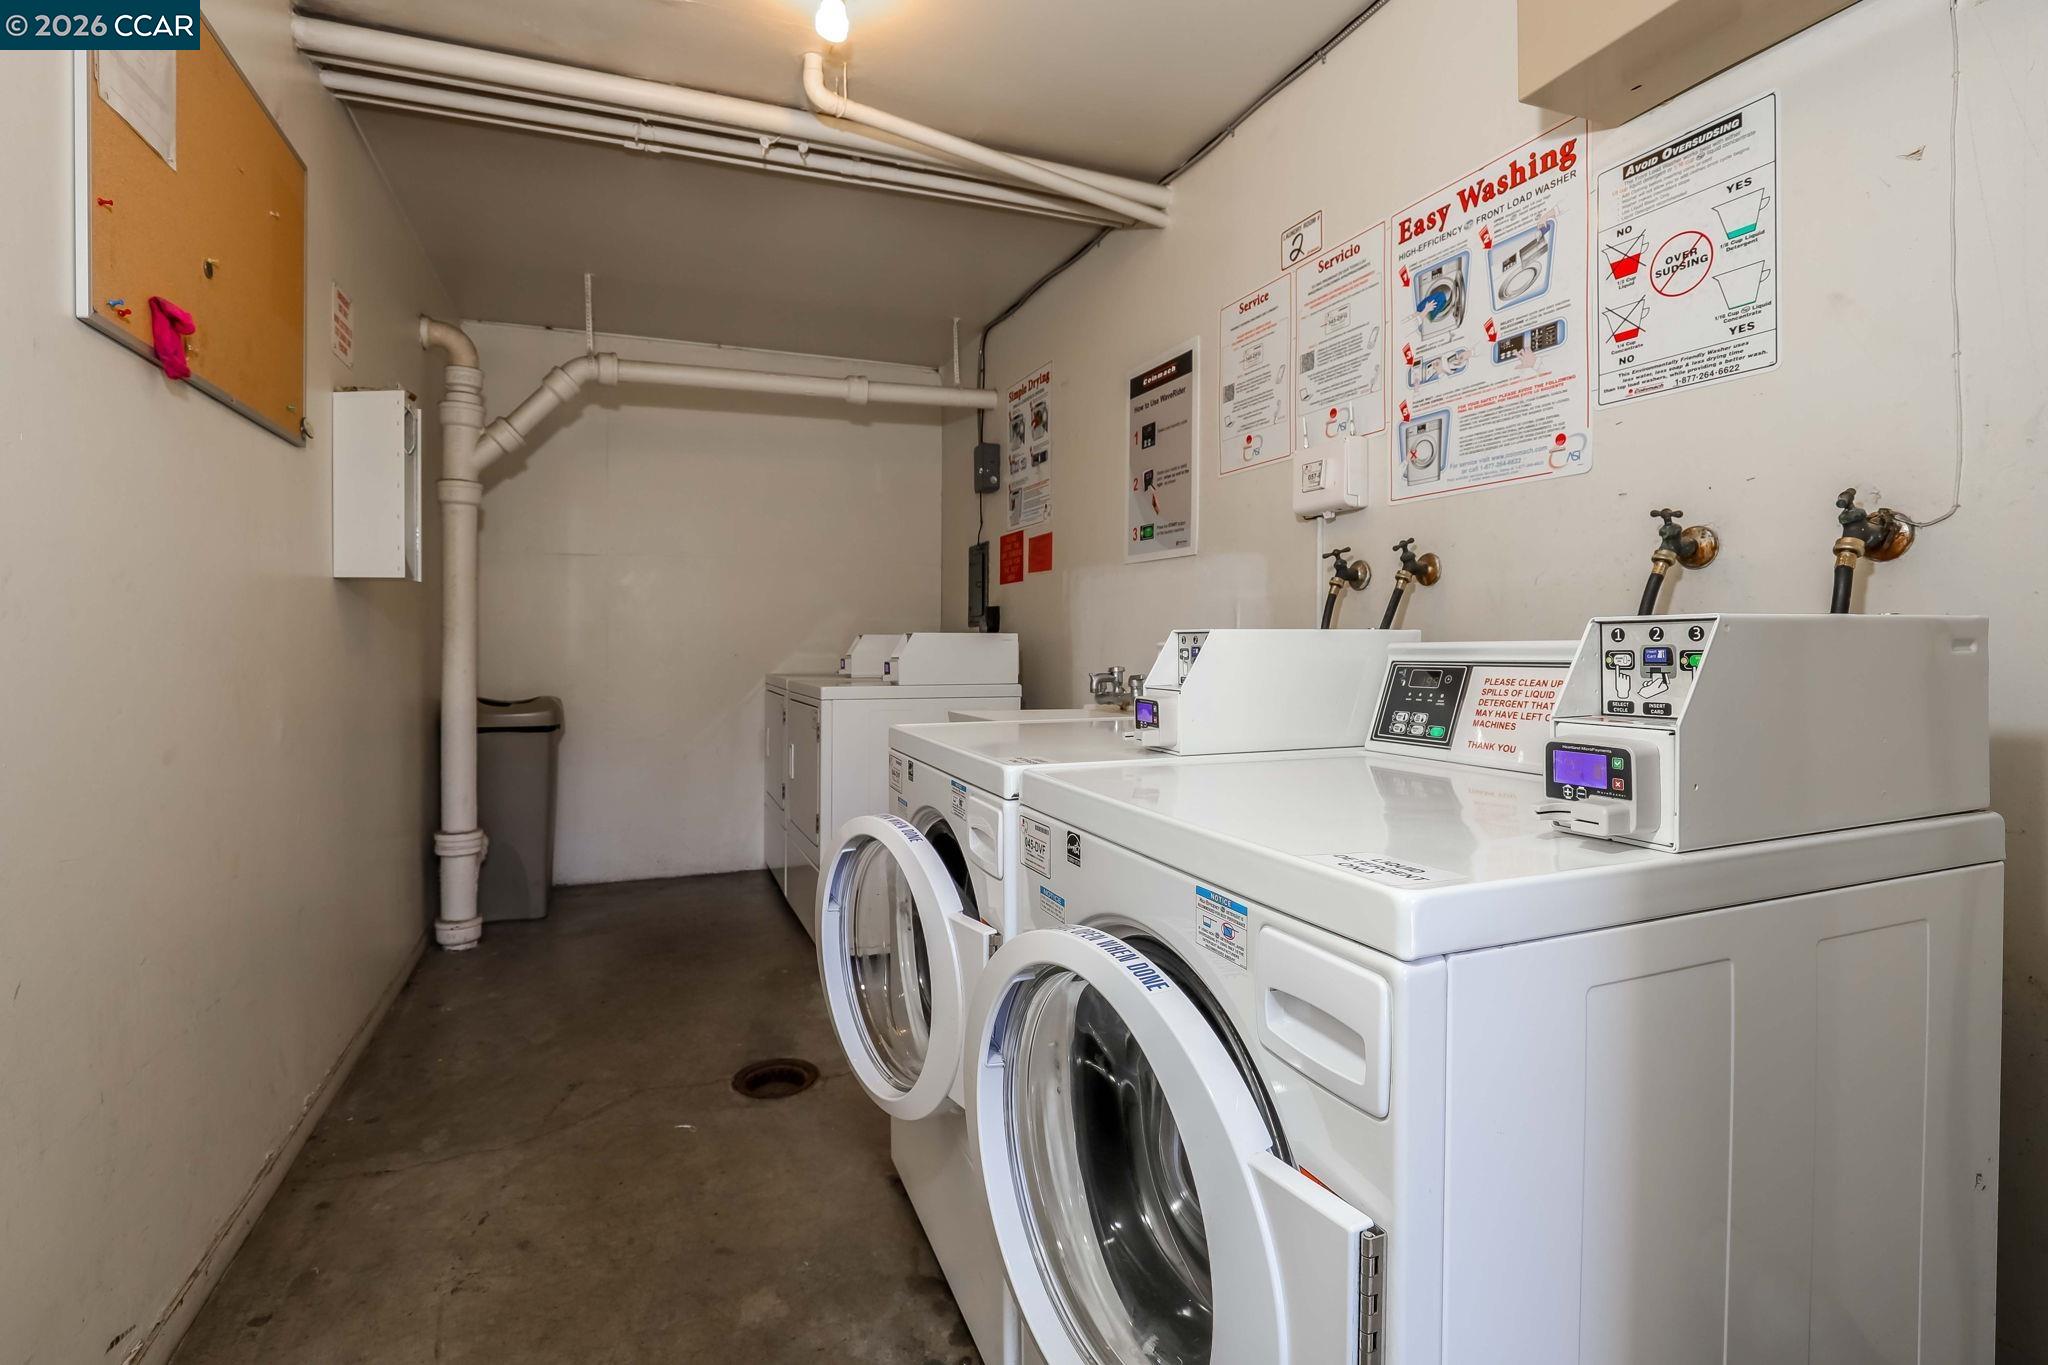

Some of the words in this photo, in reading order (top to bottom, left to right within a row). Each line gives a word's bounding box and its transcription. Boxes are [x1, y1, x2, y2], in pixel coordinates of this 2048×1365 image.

[1626, 156, 1658, 177] AVOID
[1662, 118, 1740, 160] OVERSUDSING
[1398, 204, 1451, 245] Easy
[1457, 138, 1577, 213] Washing
[1727, 178, 1752, 193] YES
[1398, 226, 1463, 262] HIGH-EFFICIENCY
[1476, 205, 1505, 224] FRONT
[1507, 191, 1533, 210] LOAD
[1535, 170, 1577, 196] WASHER
[1483, 234, 1489, 243] 2
[1617, 226, 1632, 237] NO
[1289, 233, 1305, 262] 2
[1726, 238, 1758, 252] Detergent
[1318, 244, 1361, 273] Servicio
[1665, 248, 1698, 265] OVER
[1655, 254, 1709, 279] SUDSING
[1238, 292, 1269, 314] Service
[1728, 310, 1740, 318] Cup
[1752, 301, 1772, 311] Liquid
[1723, 310, 1762, 323] Concentrate
[1488, 327, 1494, 335] 4
[1729, 322, 1755, 336] YES
[1406, 352, 1412, 360] 3
[1619, 355, 1635, 366] NO
[1632, 359, 1678, 374] Environmentally
[1681, 352, 1706, 362] Friendly
[1707, 346, 1731, 355] Washer
[1733, 341, 1749, 349] uses
[1687, 361, 1717, 374] providing
[1725, 356, 1745, 364] better
[1748, 350, 1768, 358] wash.
[1706, 353, 1726, 363] drying
[1143, 365, 1177, 386] Coinmach
[1008, 382, 1027, 403] Simple
[1028, 370, 1051, 392] Drying
[1480, 396, 1497, 404] SAFETY
[1545, 375, 1576, 386] FOLLOWING
[1145, 400, 1150, 409] to
[1160, 386, 1187, 404] WaveRider
[1134, 431, 1139, 445] 1
[1133, 478, 1138, 491] 2
[1133, 528, 1138, 541] 3
[1615, 629, 1622, 640] 1
[1653, 628, 1660, 640] 2
[1693, 627, 1700, 640] 3
[1484, 678, 1516, 686] PLEASE
[1518, 679, 1549, 687] CLEAN
[1550, 680, 1564, 688] UP
[1481, 689, 1509, 697] SPILLS
[1525, 690, 1555, 699] LIQUID
[1478, 699, 1528, 708] DETERGENT
[1532, 701, 1555, 709] THAT
[1476, 709, 1493, 717] MAY
[1495, 711, 1517, 720] HAVE
[1521, 712, 1542, 721] LEFT
[1472, 720, 1517, 731] MACHINES
[1467, 741, 1495, 750] THANK
[1497, 744, 1516, 753] YOU
[1210, 893, 1232, 905] NOTICE
[1096, 939, 1140, 962] WHEN
[1126, 962, 1169, 992] DONE
